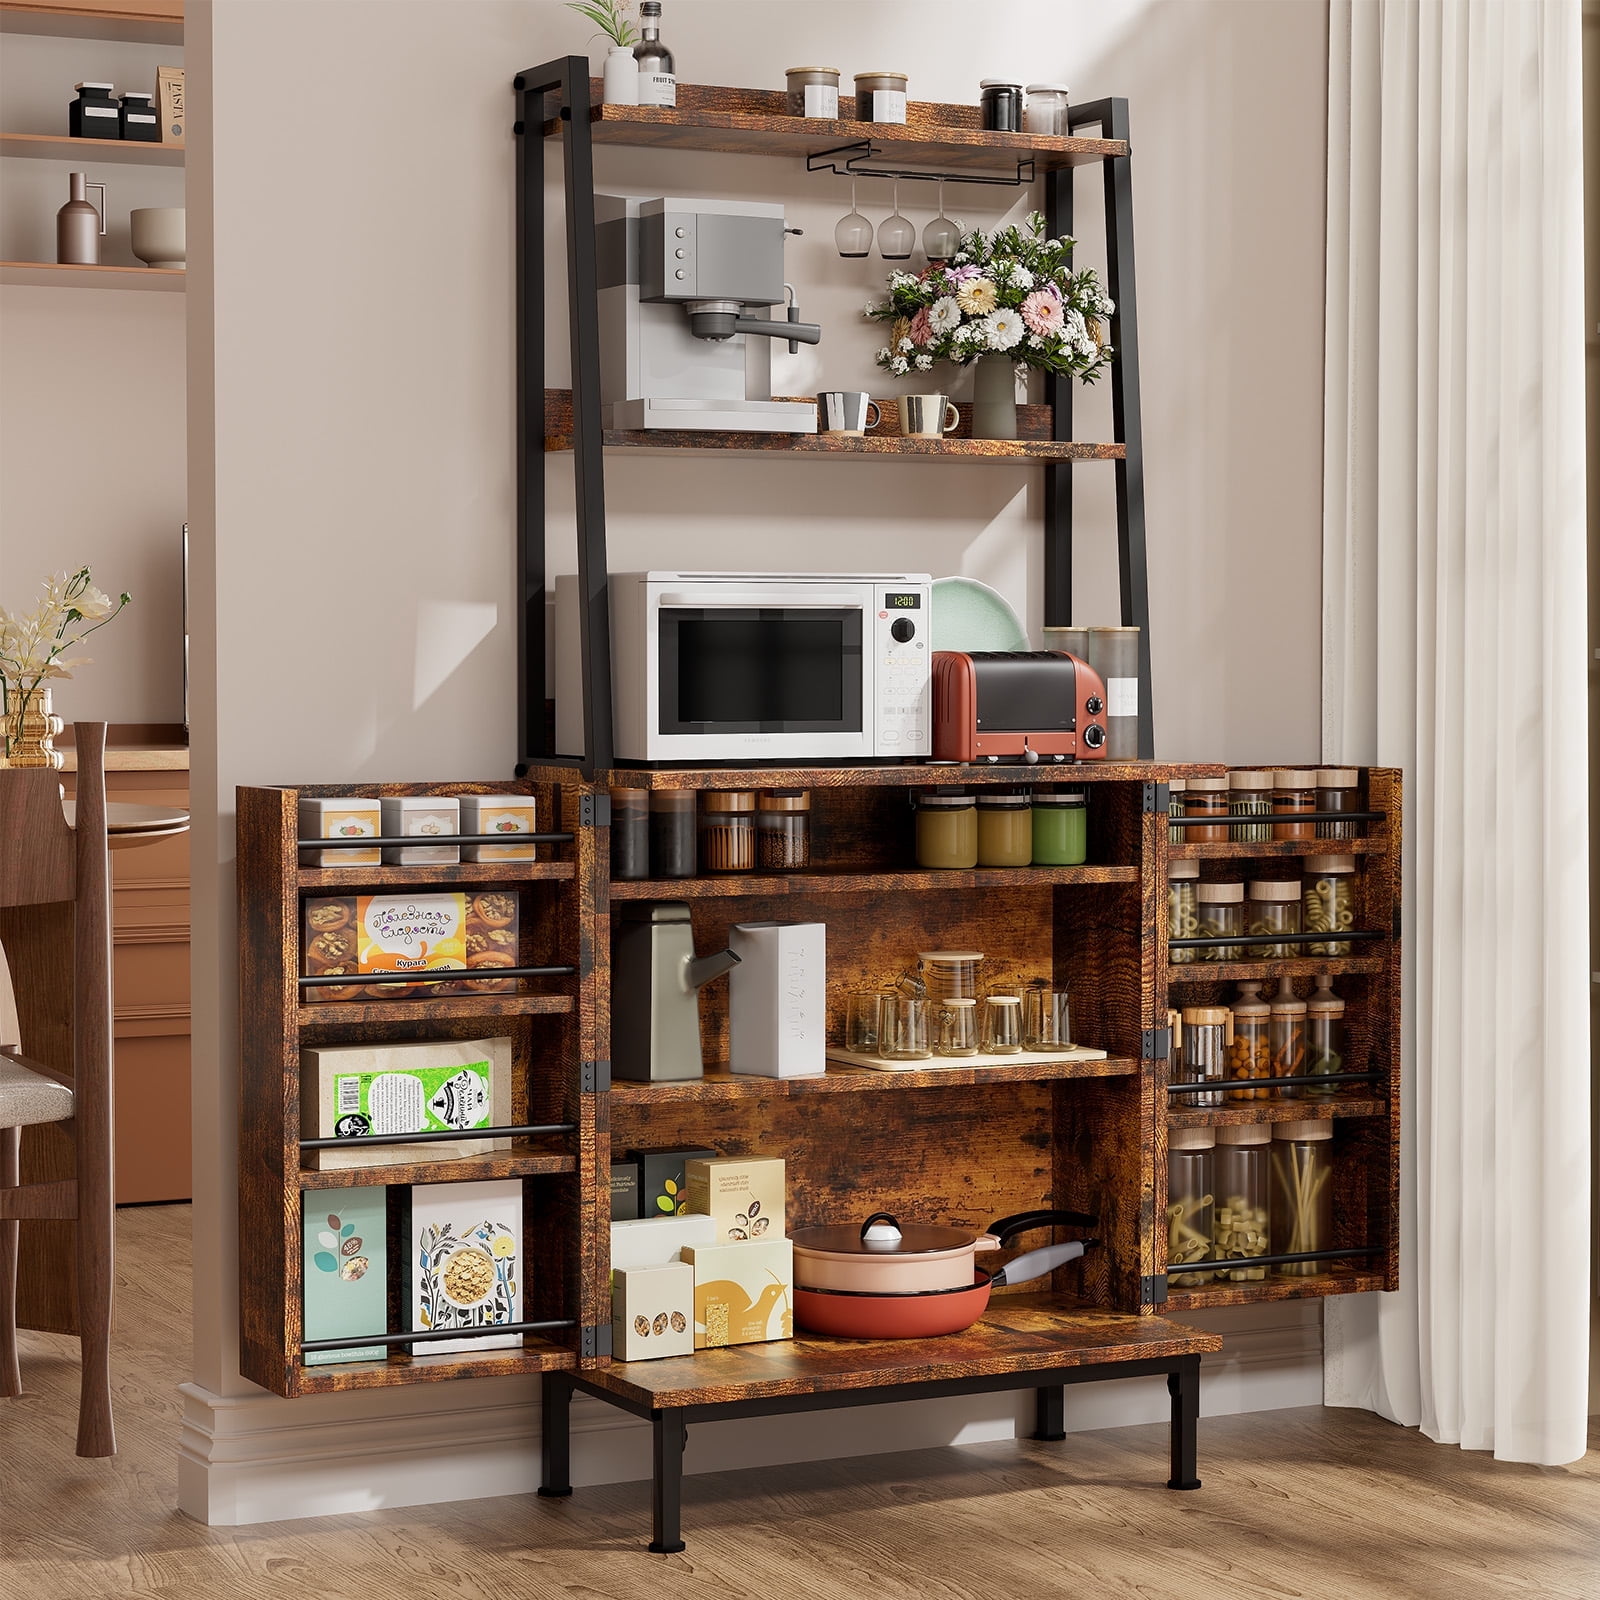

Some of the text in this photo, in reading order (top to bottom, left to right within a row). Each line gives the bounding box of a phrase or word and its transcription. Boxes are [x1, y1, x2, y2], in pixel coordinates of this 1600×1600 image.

[172, 83, 184, 119] PASTA
[894, 596, 914, 607] 12:00
[396, 959, 427, 968] Курага
